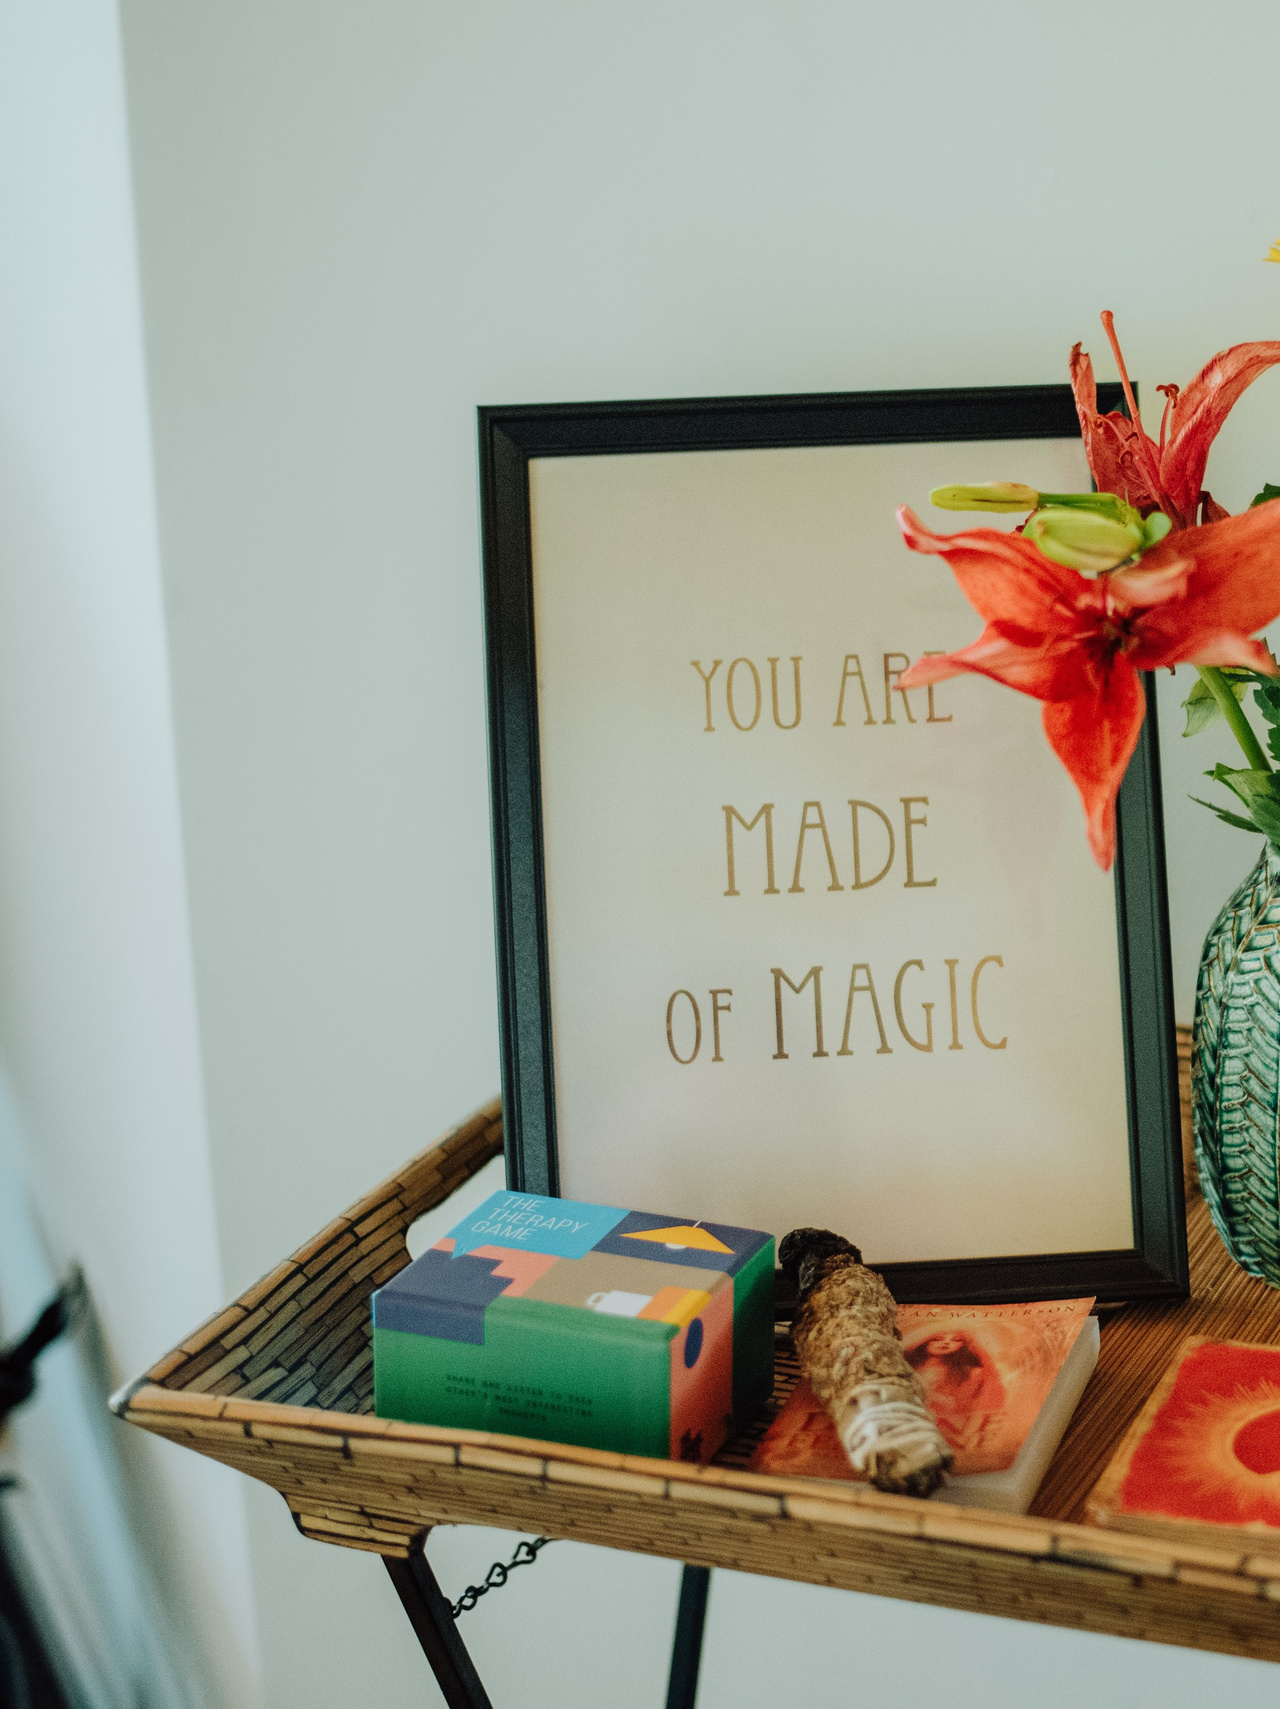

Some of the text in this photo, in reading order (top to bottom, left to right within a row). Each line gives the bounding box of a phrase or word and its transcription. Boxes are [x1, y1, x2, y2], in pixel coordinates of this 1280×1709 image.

[691, 651, 953, 732] YOU ARE
[722, 796, 938, 896] MADE
[666, 955, 1008, 1064] OF MAGIC
[503, 1195, 546, 1212] THE
[471, 1220, 538, 1240] GAME
[489, 1208, 590, 1233] THERAPY
[895, 1305, 1076, 1319] GAN WATTERSON
